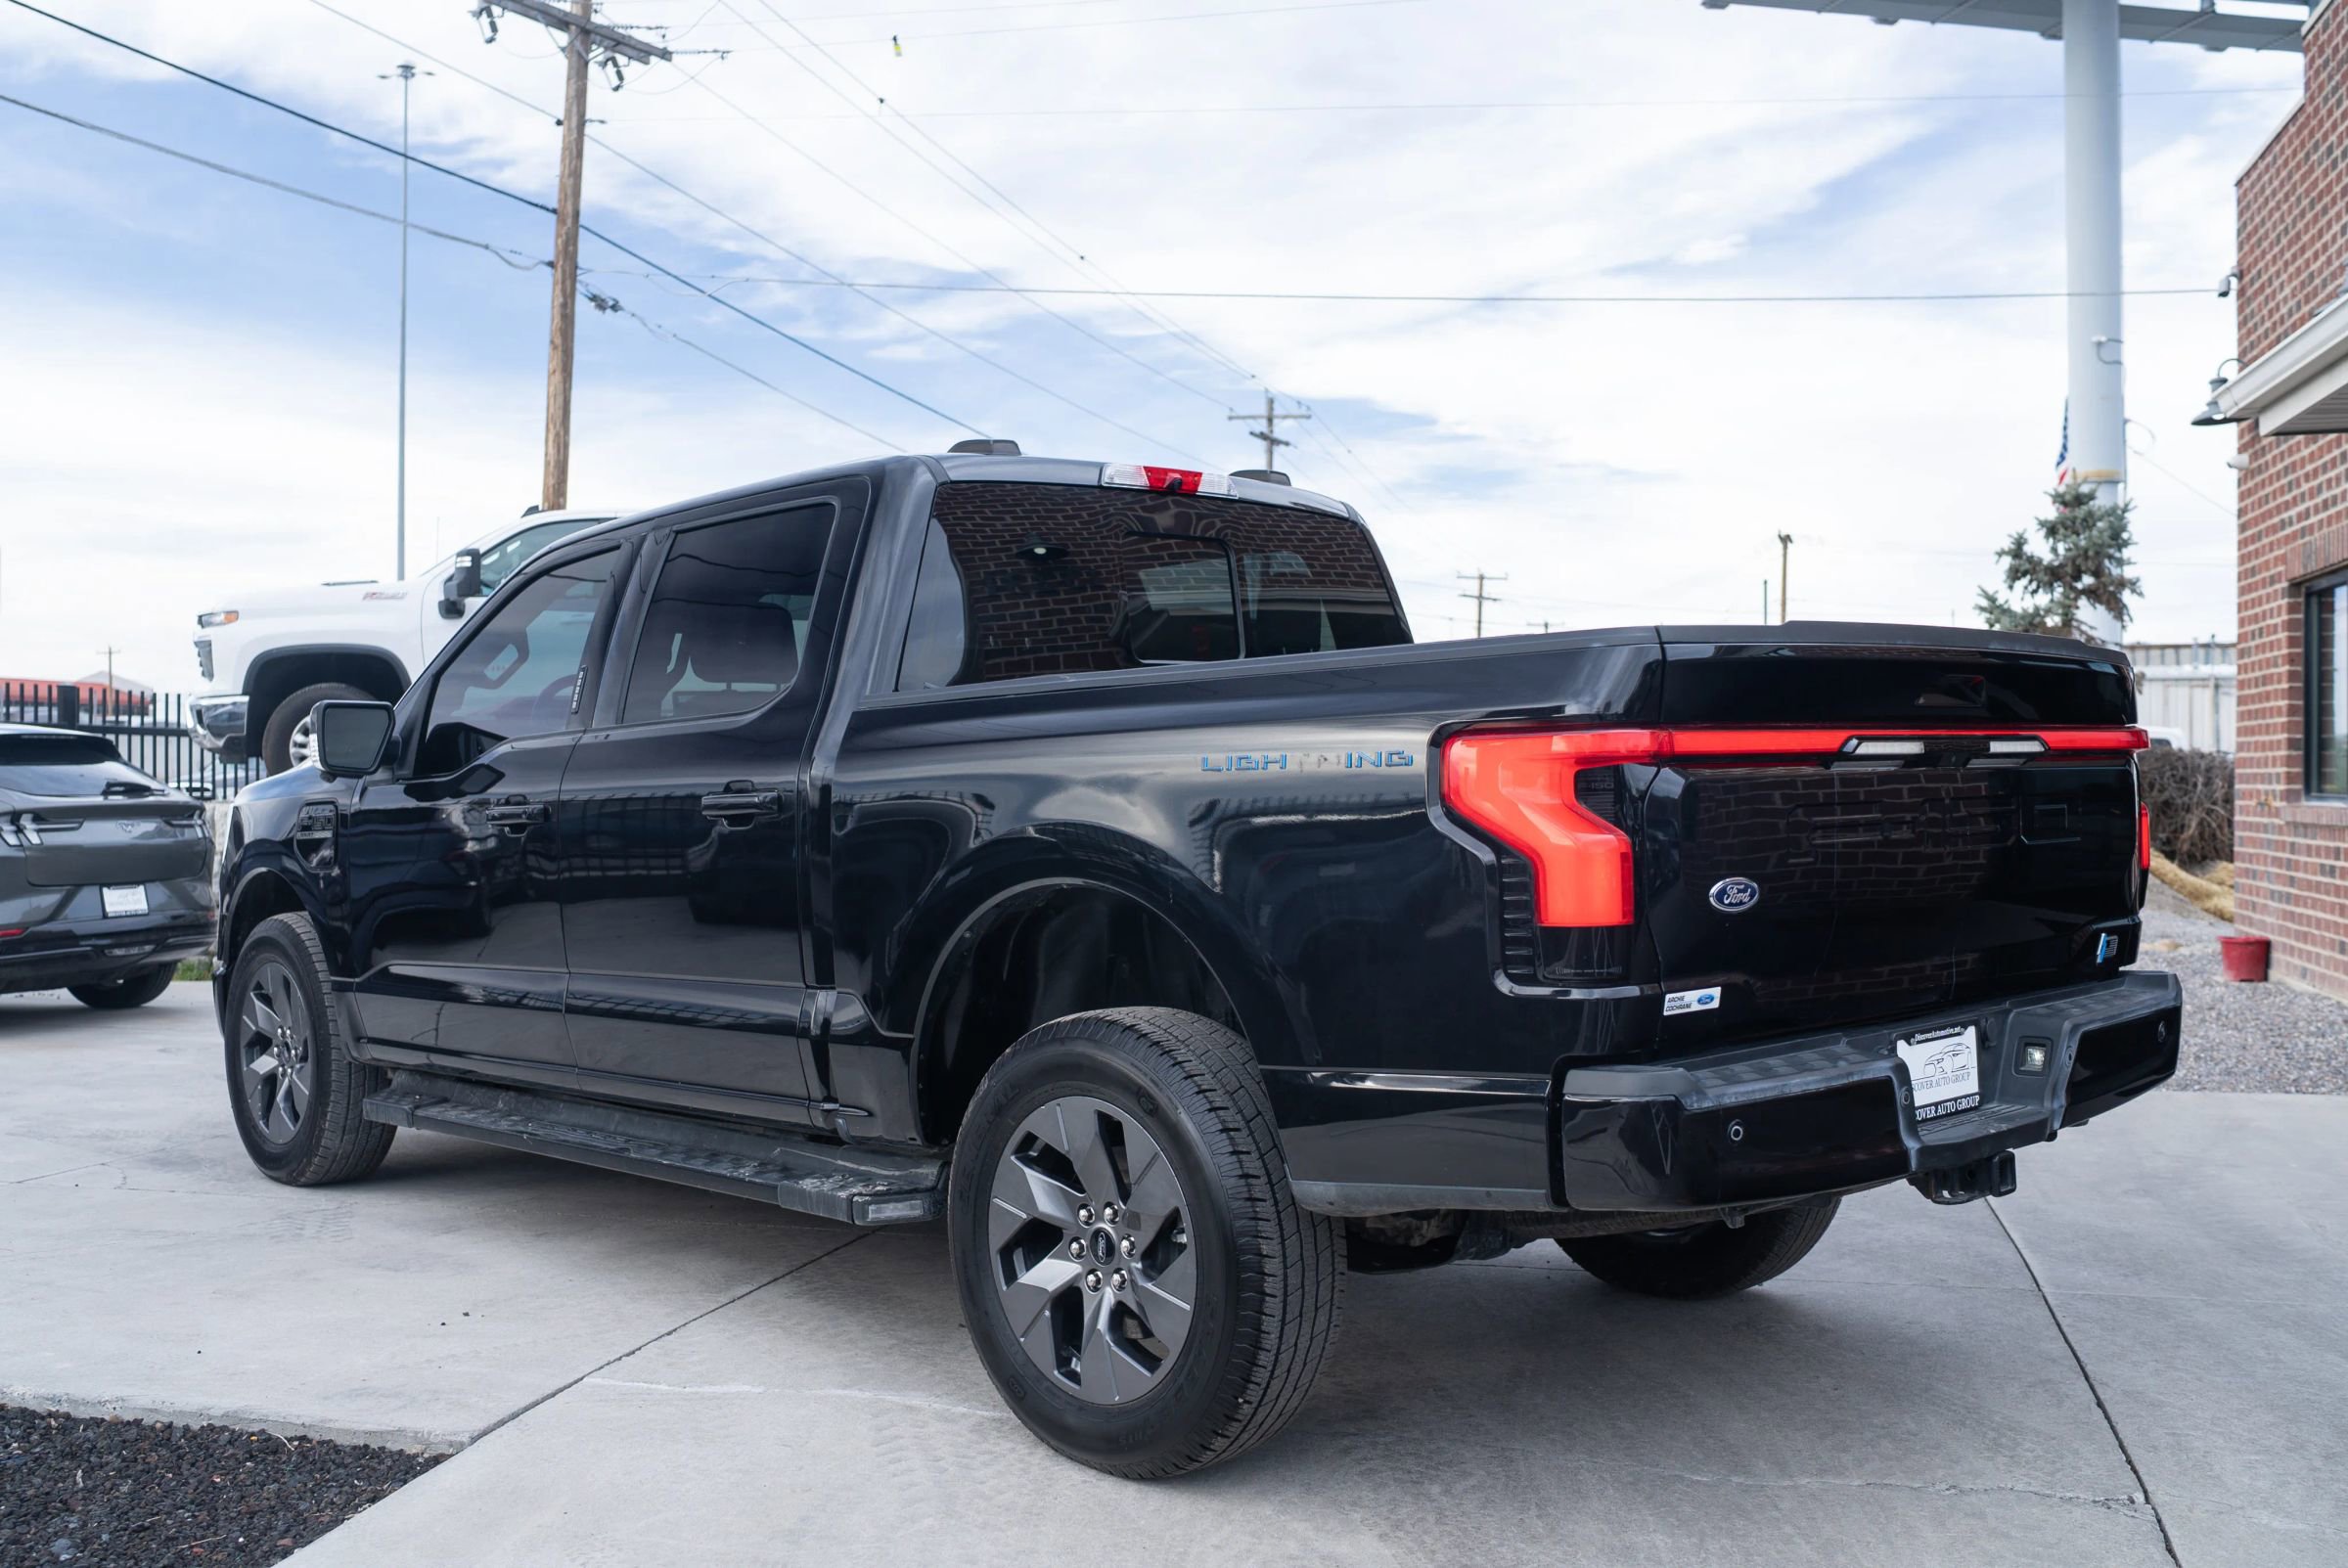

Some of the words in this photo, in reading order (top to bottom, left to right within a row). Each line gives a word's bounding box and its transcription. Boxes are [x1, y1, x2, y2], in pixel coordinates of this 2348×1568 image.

[1200, 749, 1414, 773] LIGHING
[1723, 883, 1751, 904] Ford
[1665, 1002, 1693, 1012] COCHRANE
[1667, 995, 1686, 1004] ARCHIE
[1912, 1080, 1934, 1093] SCOVER
[1934, 1075, 1951, 1088] AUTO
[1951, 1071, 1971, 1085] GROUP
[1937, 1101, 1957, 1116] AUTO
[1957, 1095, 1980, 1111] GROUP
